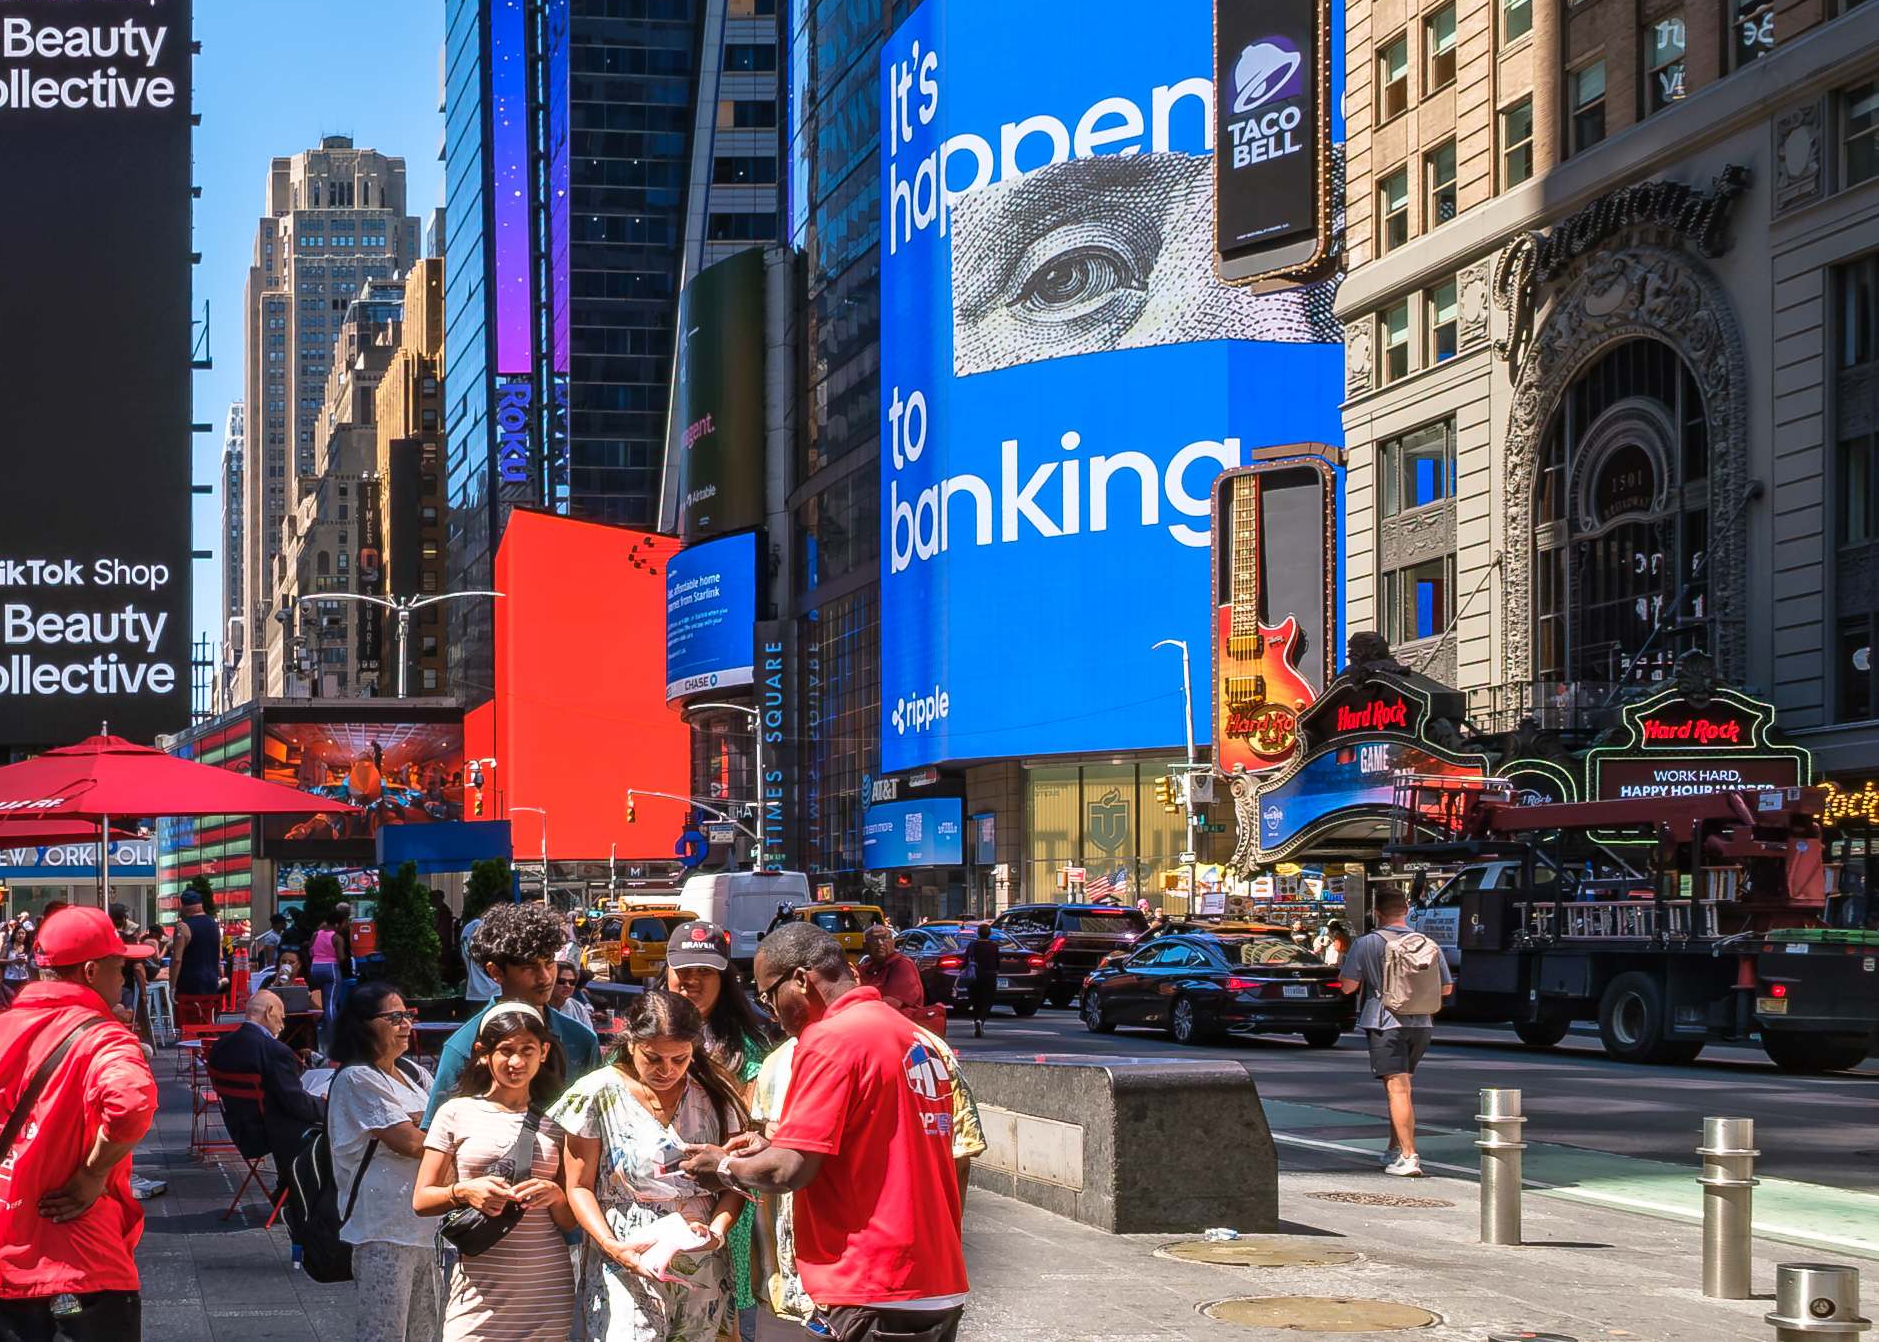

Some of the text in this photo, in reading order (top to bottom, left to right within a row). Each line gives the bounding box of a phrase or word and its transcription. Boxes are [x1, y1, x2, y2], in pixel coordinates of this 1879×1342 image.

[1228, 106, 1301, 146] TACO
[890, 78, 1213, 255] happen
[1233, 130, 1300, 169] BELL
[498, 383, 532, 482] ROKU
[889, 386, 927, 470] to
[891, 431, 1241, 574] banking
[94, 559, 168, 590] Shop
[684, 676, 709, 691] CHASE
[765, 641, 783, 743] SQUARE
[906, 685, 950, 732] ripple
[1225, 711, 1295, 739] Hard Ro
[1337, 696, 1407, 731] Hard Rock
[1644, 719, 1741, 744] Hard Rock
[1360, 744, 1390, 774] GAME
[1654, 769, 1742, 783] WORK HARD,
[765, 770, 783, 845] TIMES
[872, 778, 900, 803] AT&T
[1620, 785, 1668, 799] HAPPY
[1671, 784, 1713, 797] HOUR
[34, 846, 94, 866] YORK
